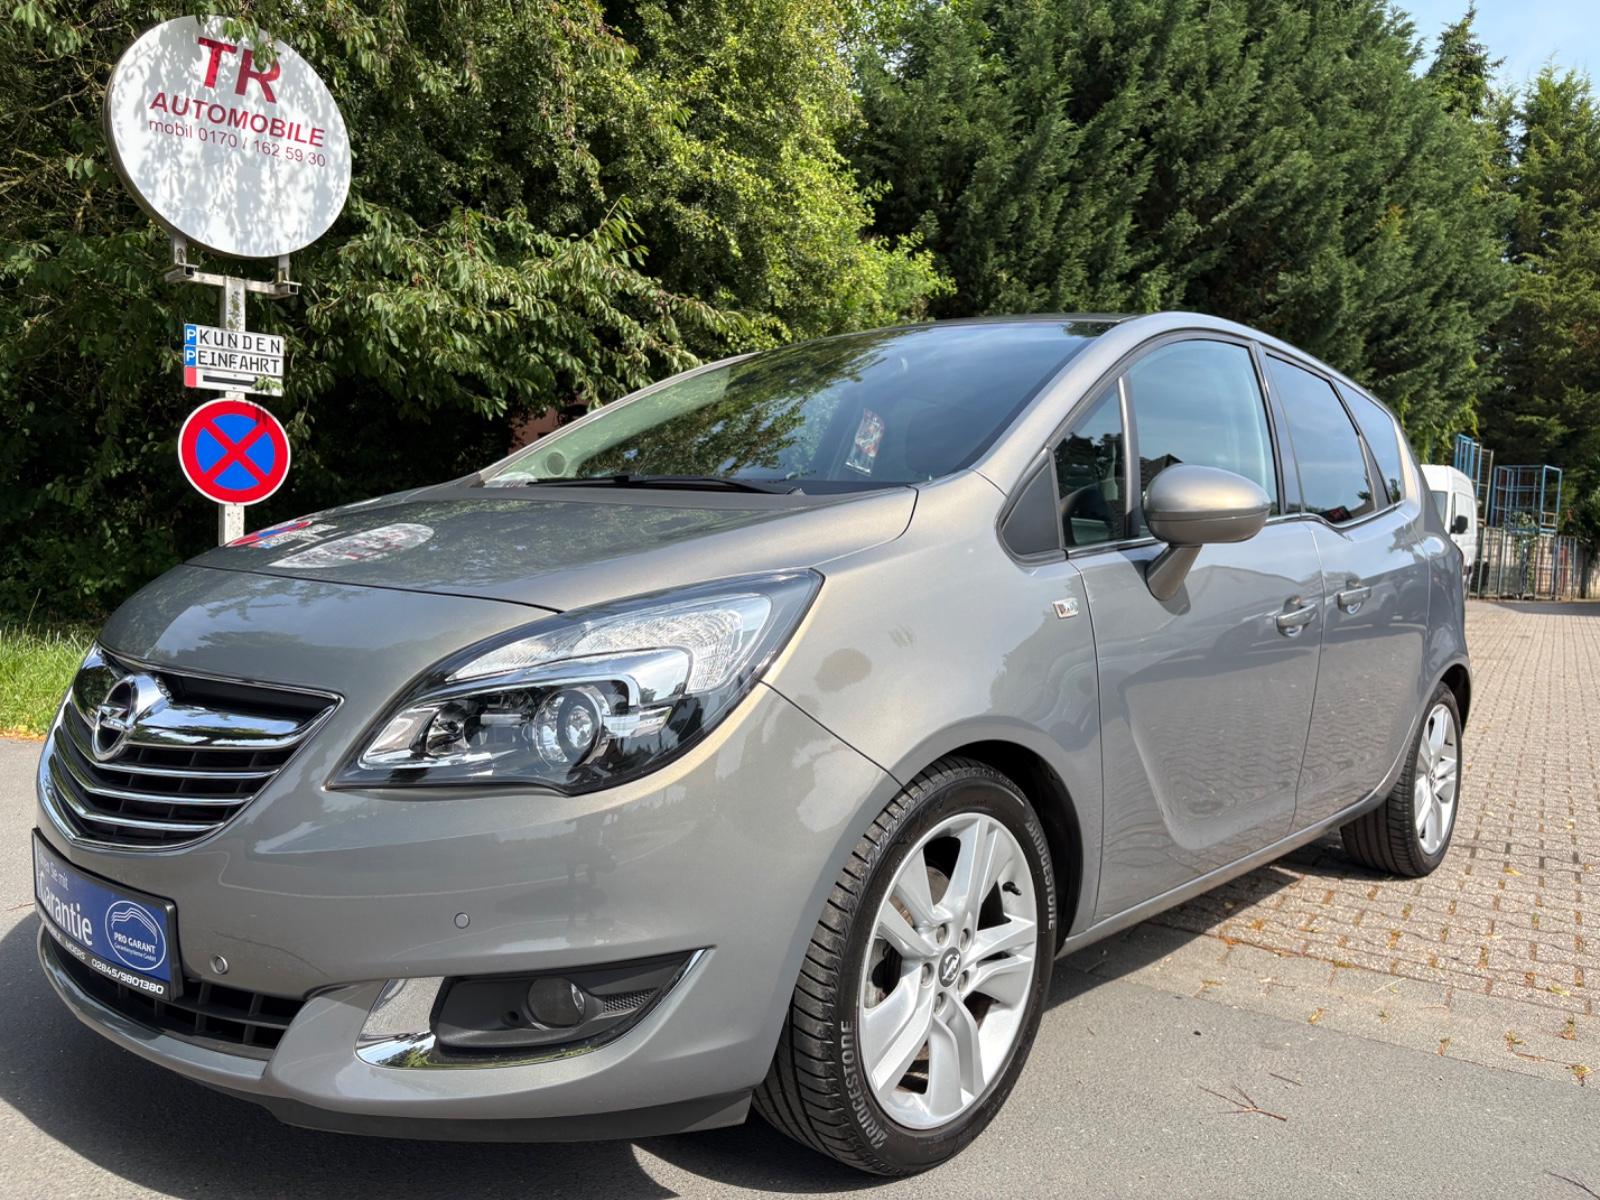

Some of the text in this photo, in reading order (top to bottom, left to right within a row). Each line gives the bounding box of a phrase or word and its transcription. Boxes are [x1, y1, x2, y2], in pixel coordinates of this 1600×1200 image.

[197, 36, 281, 103] TR
[149, 92, 325, 147] AUTOMOBILE
[149, 120, 326, 168] mobil 0170 / 162 59 30
[198, 350, 280, 374] EINFAHRT
[199, 329, 281, 354] KUNDEN
[1025, 815, 1057, 931] BRIDGESTONE
[113, 932, 157, 955] PRO GARANT
[91, 957, 165, 995] 02845/9801380
[840, 1020, 888, 1150] BRIDGESTONE
